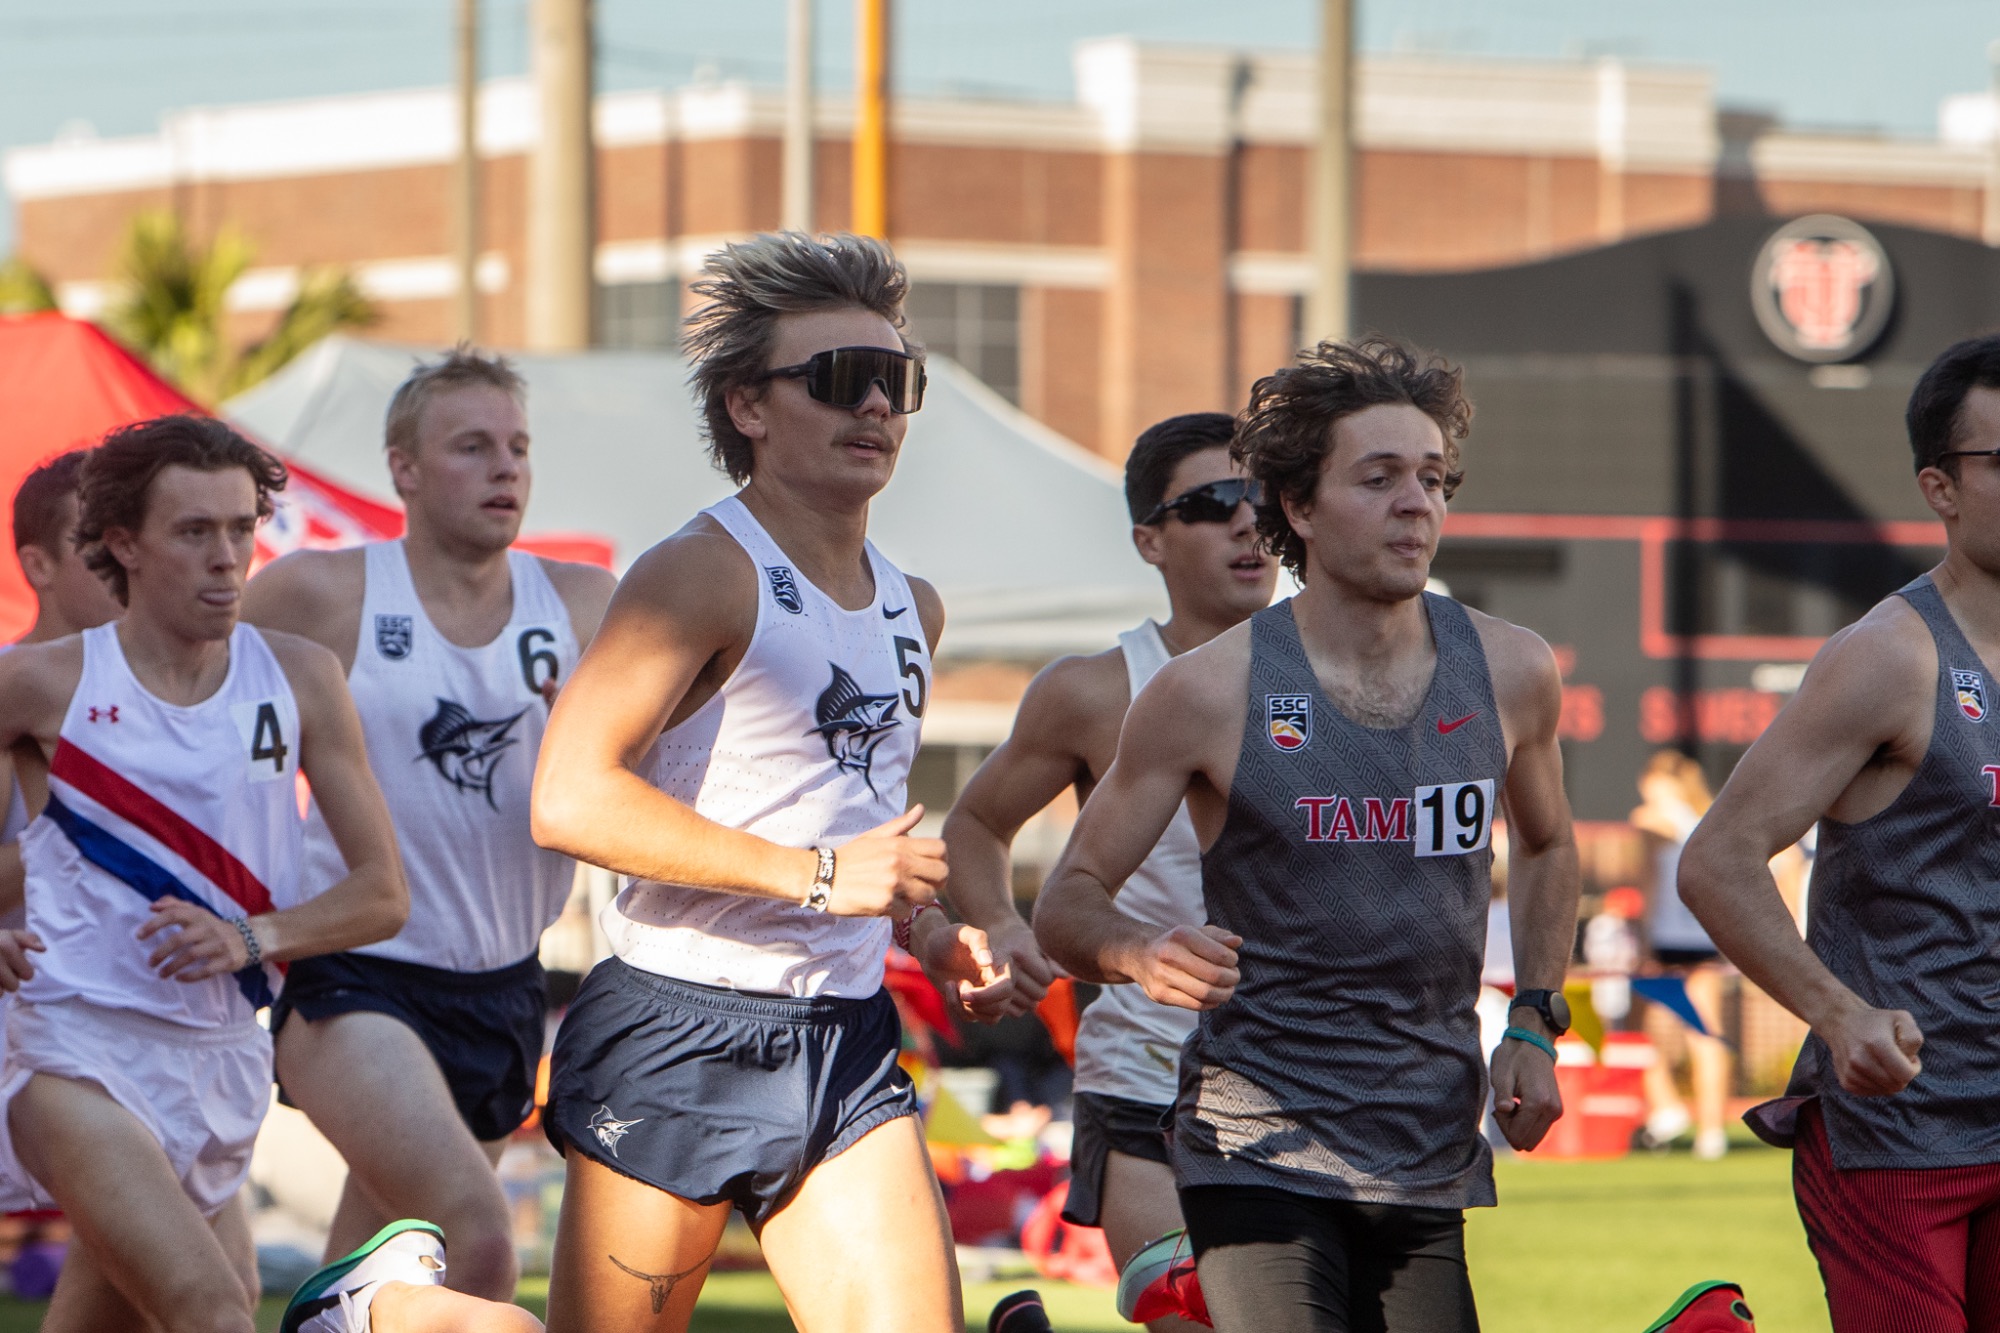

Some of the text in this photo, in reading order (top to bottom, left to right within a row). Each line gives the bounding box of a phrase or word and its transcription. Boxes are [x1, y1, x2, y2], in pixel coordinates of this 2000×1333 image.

[518, 628, 558, 695] 6
[893, 635, 925, 719] 5
[251, 702, 288, 773] 4
[1271, 699, 1307, 712] SSC
[1295, 794, 1417, 842] TAM
[1422, 784, 1485, 851] 19
